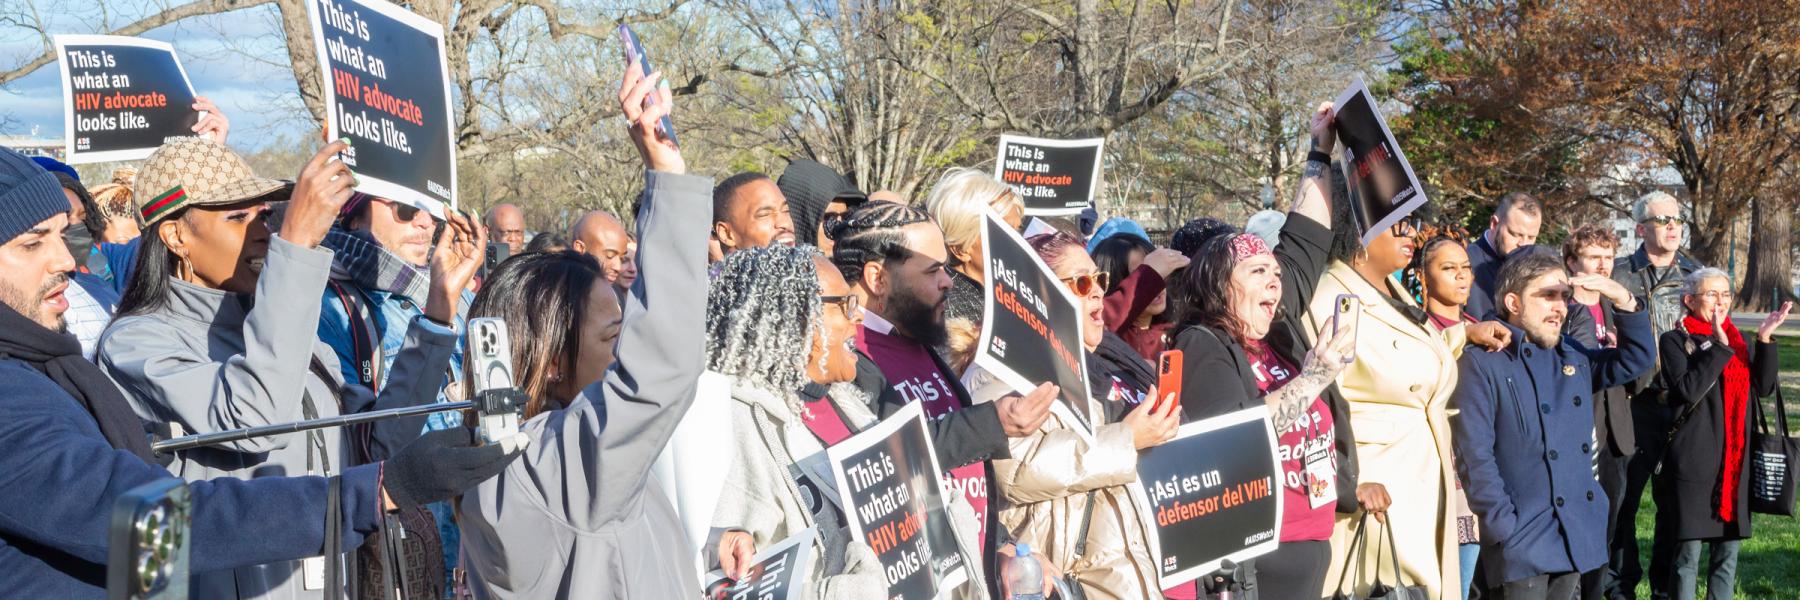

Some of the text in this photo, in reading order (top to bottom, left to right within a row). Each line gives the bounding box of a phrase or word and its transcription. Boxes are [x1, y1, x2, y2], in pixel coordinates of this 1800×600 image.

[320, 0, 370, 42] This is
[68, 50, 116, 68] This is
[327, 36, 386, 79] what an
[73, 72, 129, 89] what an
[76, 91, 167, 110] HIV advocate
[334, 69, 423, 126] HIV advocate
[77, 112, 149, 132] looks like.
[338, 103, 413, 155] looks like.
[1006, 159, 1050, 172] what an
[1008, 145, 1044, 159] This is
[1004, 171, 1072, 185] HIV advocate
[1034, 186, 1057, 198] like.
[995, 284, 1047, 339] defensor
[1020, 280, 1033, 303] es
[1035, 298, 1048, 319] un
[362, 359, 372, 383] EOS
[894, 377, 938, 403] This
[847, 453, 894, 490] This is
[1149, 470, 1221, 506] ¡Así es un
[860, 487, 897, 523] what
[895, 483, 909, 505] an
[1158, 496, 1218, 526] defensor
[1223, 485, 1244, 507] del
[1244, 476, 1271, 501] VIH!
[868, 522, 898, 555] HIV
[887, 551, 917, 585] ooks
